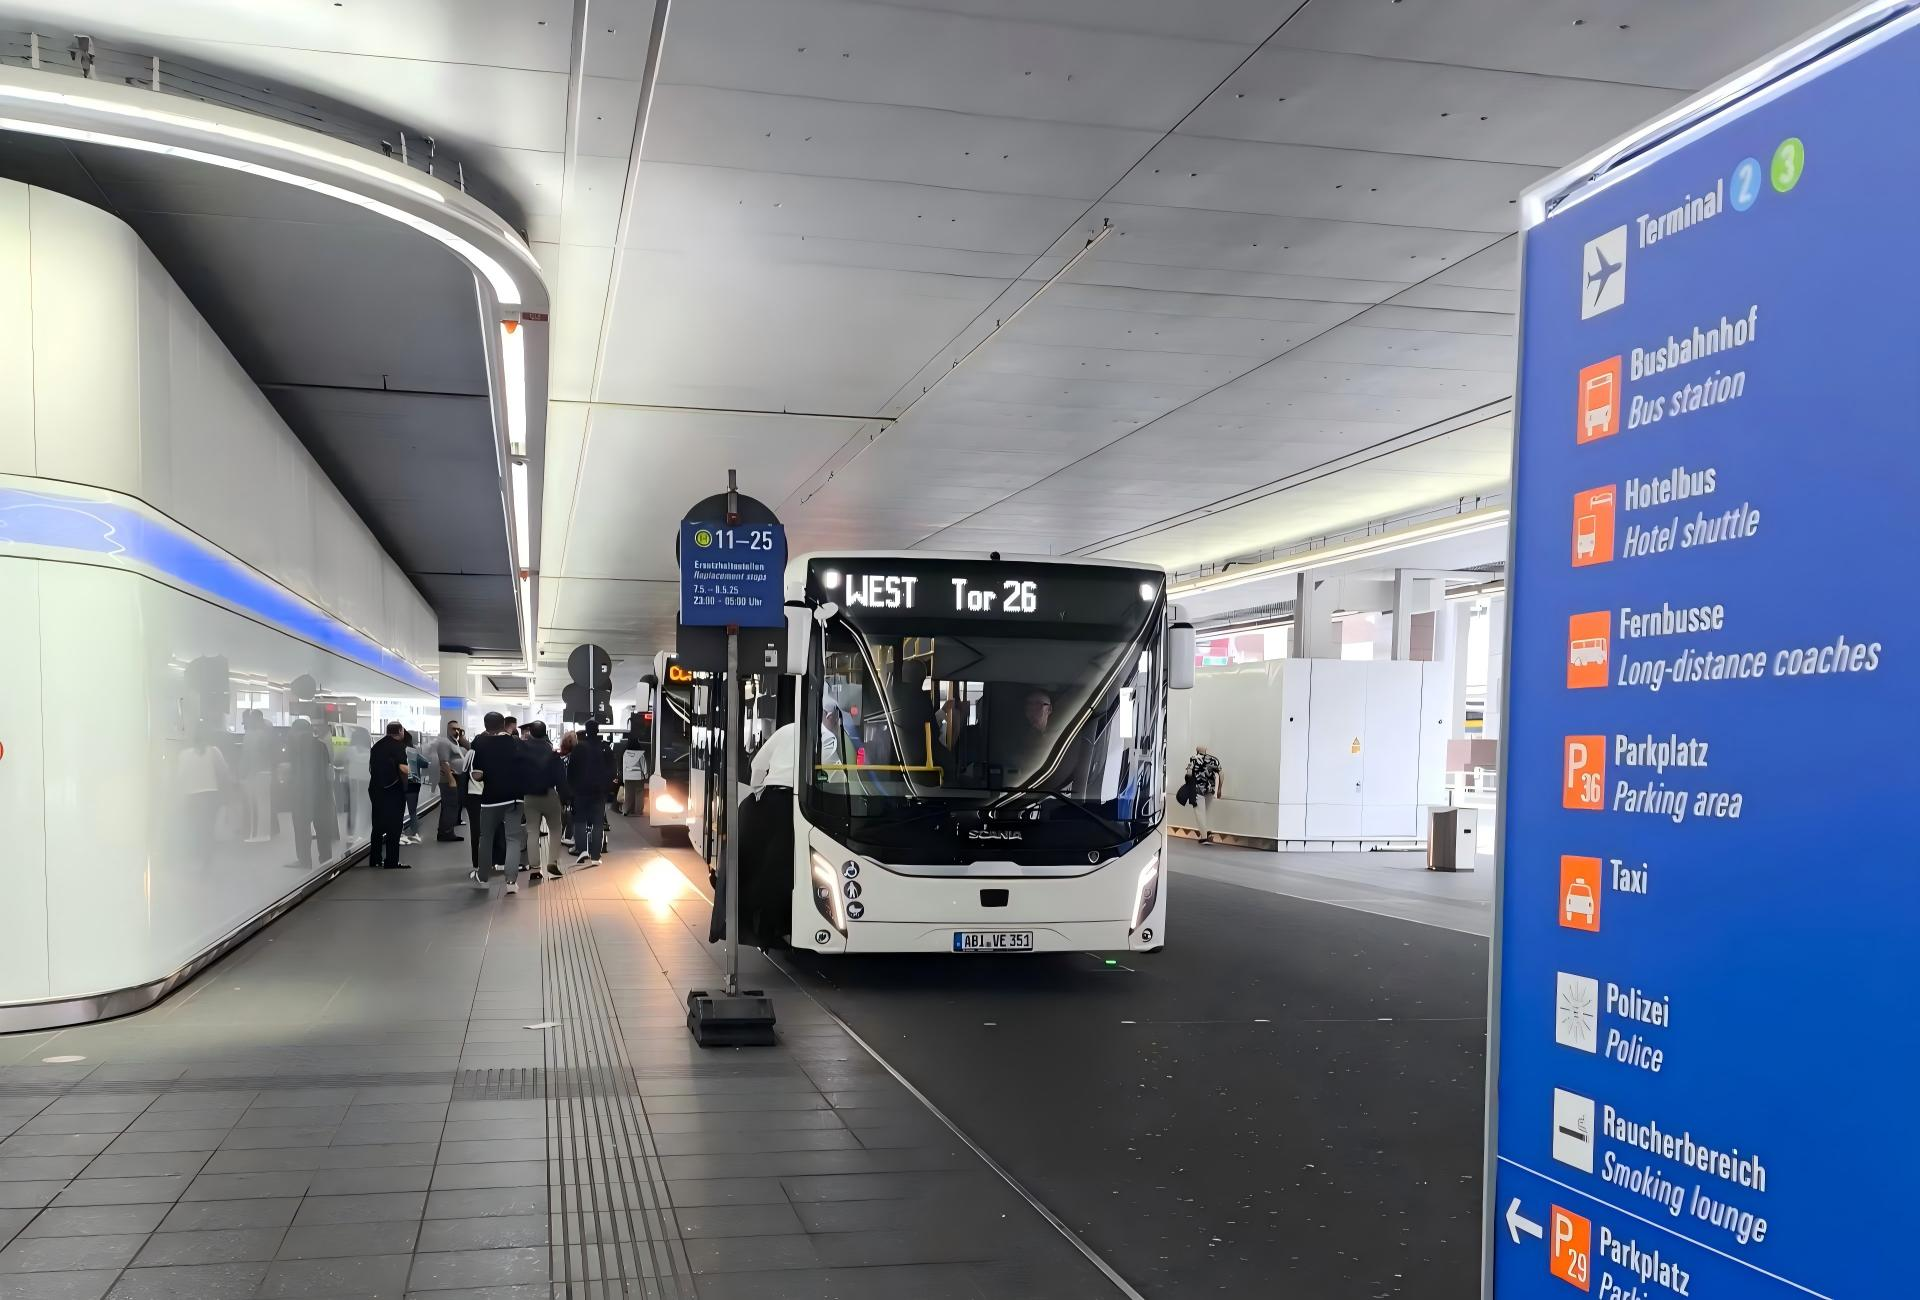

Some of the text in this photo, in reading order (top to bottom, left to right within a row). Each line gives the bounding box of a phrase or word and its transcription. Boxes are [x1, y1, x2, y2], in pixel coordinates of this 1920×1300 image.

[1636, 144, 1797, 249] Terminal 2 3
[1630, 304, 1758, 382] Busbahnhof
[1627, 369, 1746, 430] Bus station
[1625, 465, 1717, 512] Hotelbus
[1622, 501, 1761, 559] Hotel shuttle
[746, 573, 767, 582] stops
[845, 573, 1038, 614] WEST Tor 26
[748, 597, 763, 607] Uhr
[1619, 602, 1725, 640] Fernbusse
[1617, 634, 1883, 692] Long-distance coaches
[1567, 742, 1602, 804] P 36
[1615, 733, 1709, 775] Parkplatz
[1612, 780, 1744, 824] Parking area
[968, 830, 1023, 841] SCANIA
[1609, 858, 1648, 896] Taxi
[1009, 934, 1030, 948] 351
[1606, 982, 1669, 1028] Polizei
[1604, 1028, 1664, 1073] Police
[1603, 1104, 1767, 1192] Raucherbereich
[1601, 1150, 1768, 1246] Smoking lounge
[1554, 1212, 1588, 1284] P 29
[1600, 1225, 1690, 1298] Parkplatz
